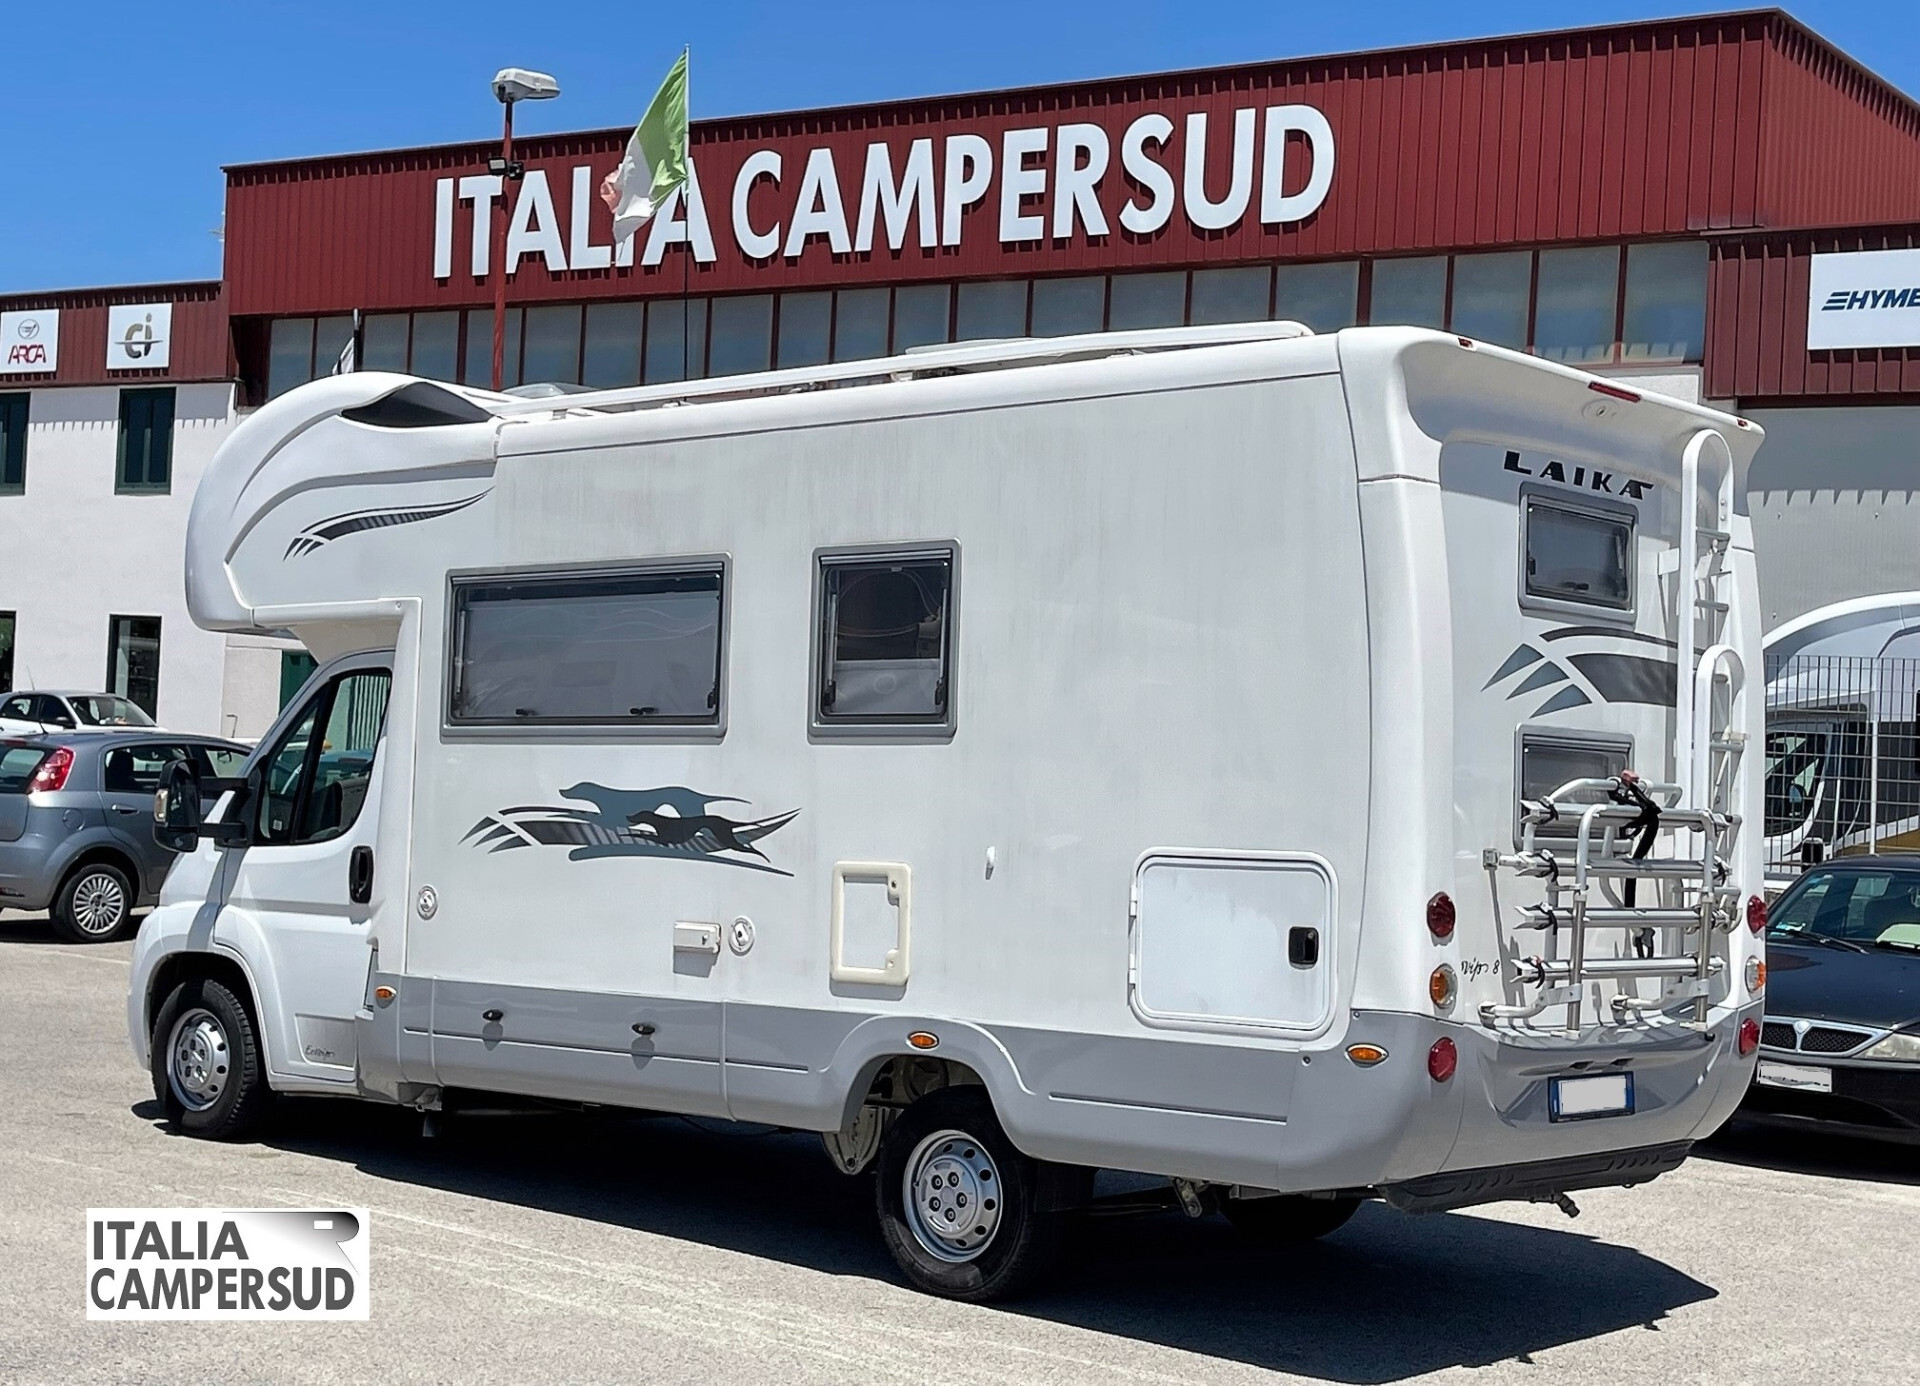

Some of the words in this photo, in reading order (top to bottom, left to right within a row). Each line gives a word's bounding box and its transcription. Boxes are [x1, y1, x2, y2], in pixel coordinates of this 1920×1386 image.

[732, 104, 1335, 258] CAMPERSUD
[8, 343, 47, 364] ARCA
[1503, 450, 1654, 500] LAIKA
[1493, 959, 1500, 975] 8
